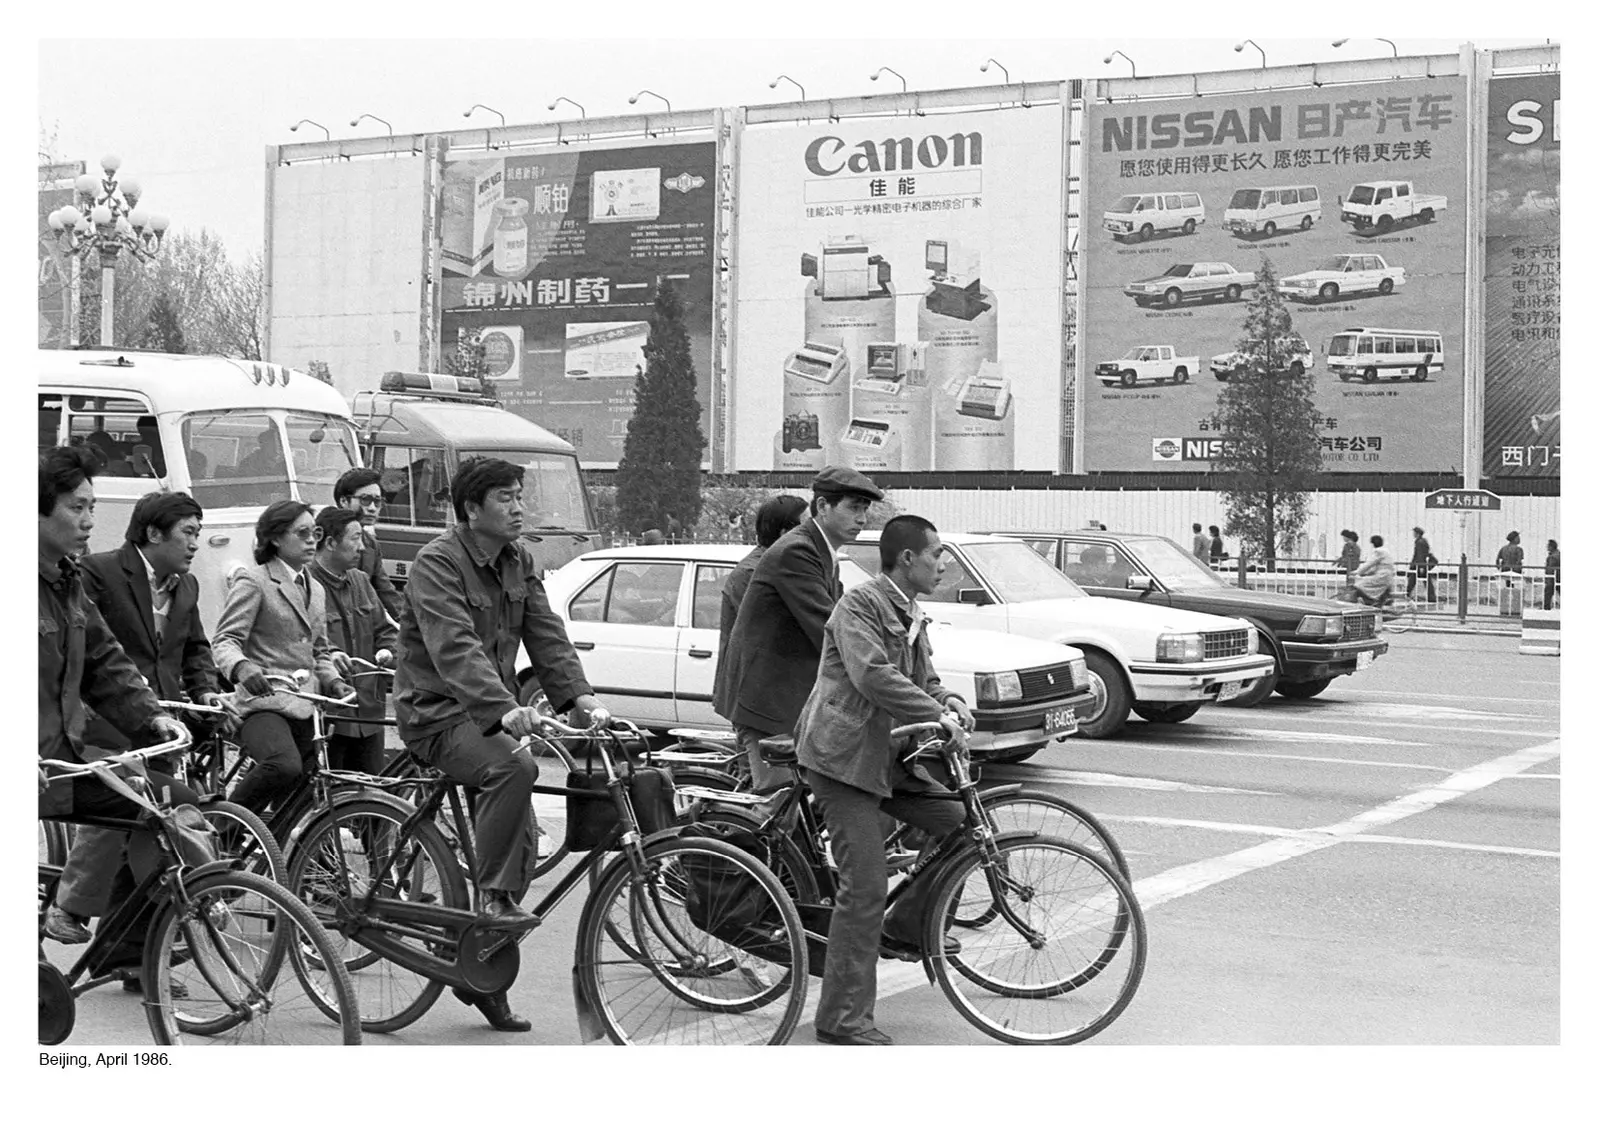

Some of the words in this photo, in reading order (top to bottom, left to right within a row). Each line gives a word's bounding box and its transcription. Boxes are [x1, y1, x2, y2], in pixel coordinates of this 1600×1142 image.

[1102, 105, 1282, 152] NISSAN
[1297, 94, 1454, 140] 日产汽车
[805, 131, 982, 177] Canon
[1120, 150, 1268, 178] 愿您使用得更长久
[1272, 139, 1433, 169] 愿您工作得更完美
[869, 176, 916, 198] 佳能
